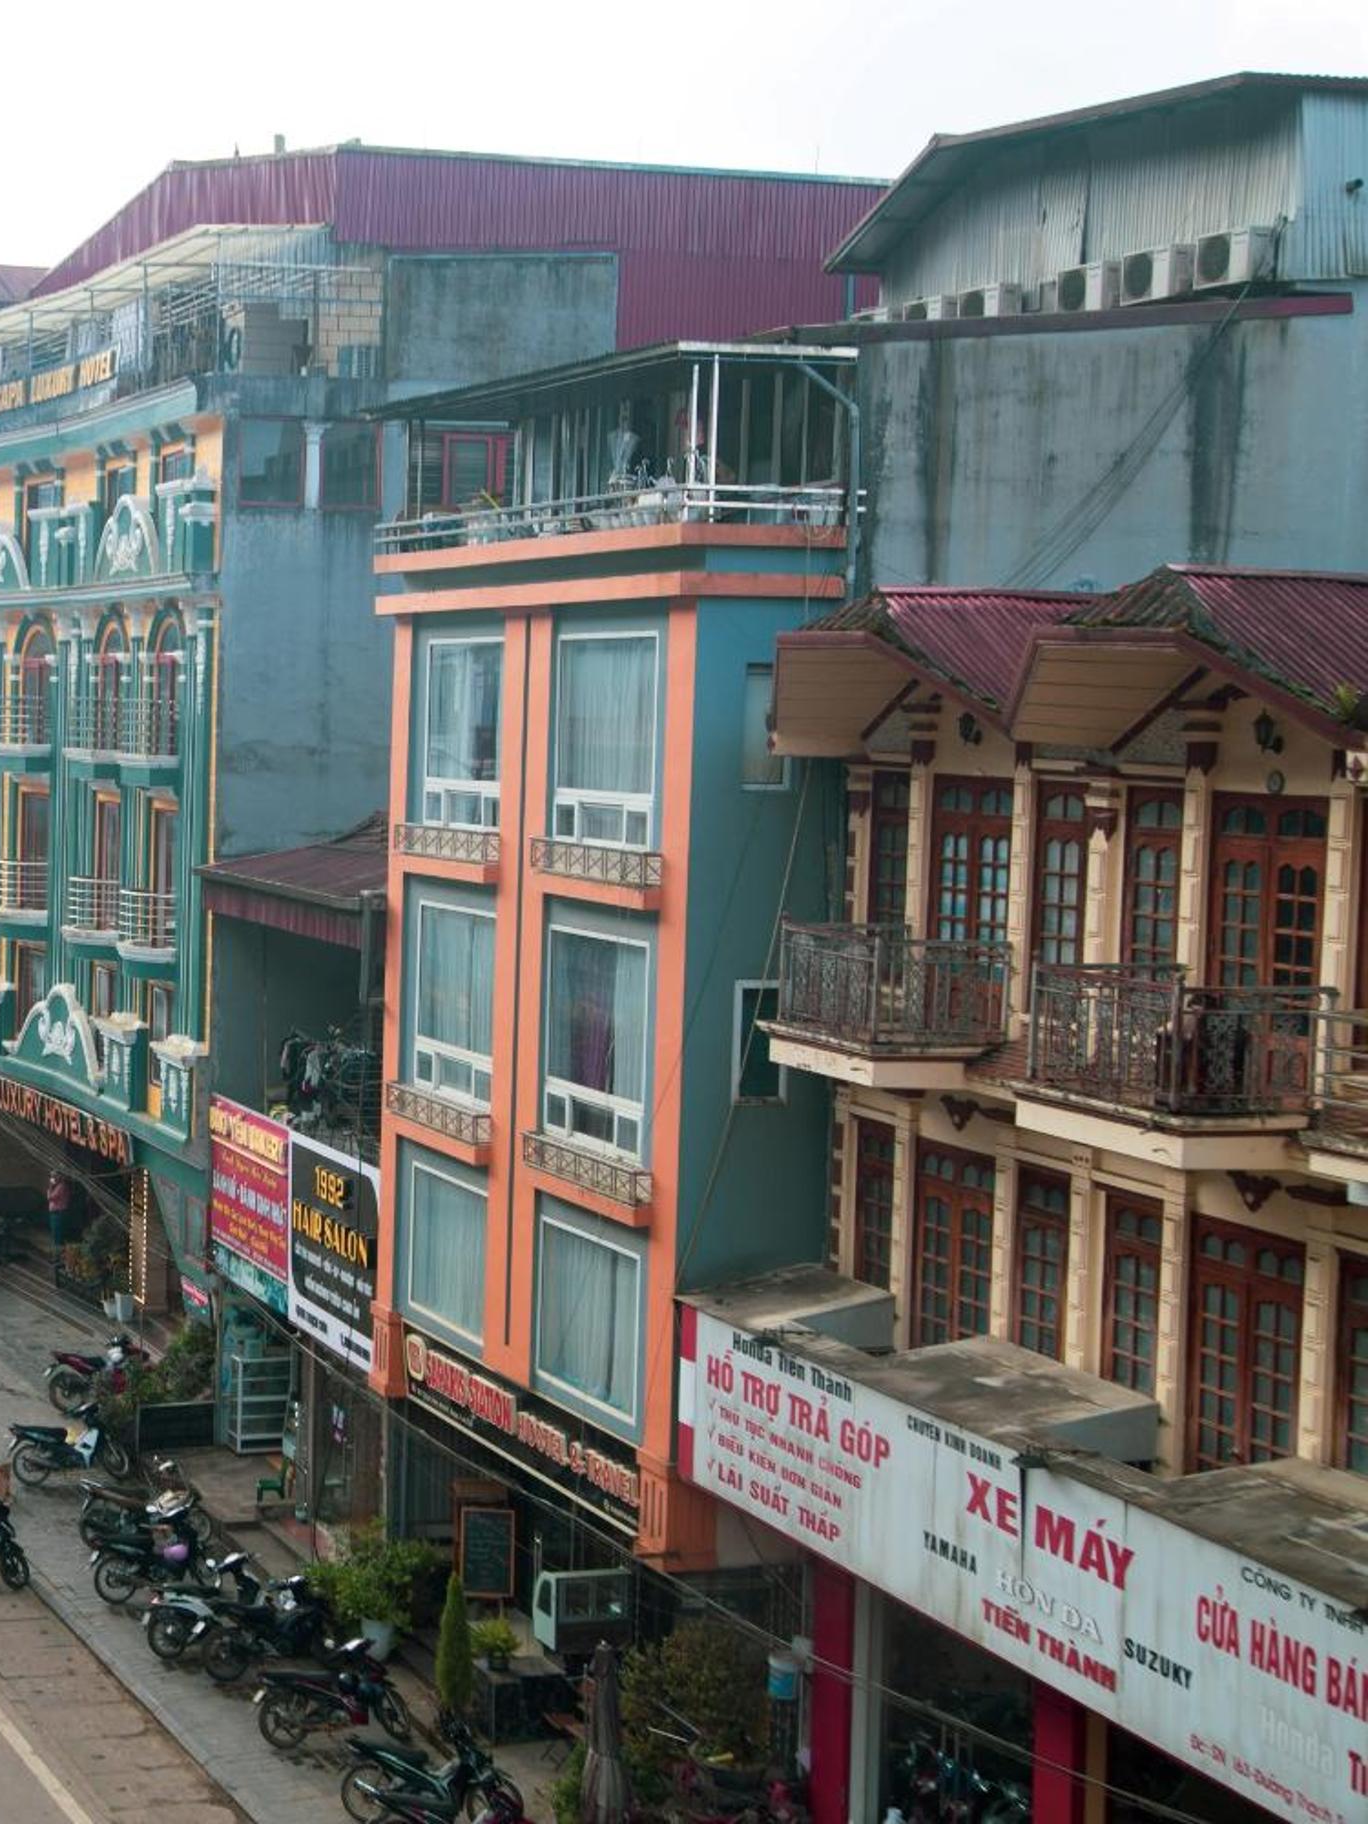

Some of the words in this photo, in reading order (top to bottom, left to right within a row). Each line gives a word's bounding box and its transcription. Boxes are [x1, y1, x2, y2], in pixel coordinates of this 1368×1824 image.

[43, 1097, 86, 1147] HOTEL
[87, 1117, 97, 1150] &
[99, 1124, 128, 1166] SPA
[315, 1166, 344, 1209] 1992
[293, 1199, 322, 1244] HAIR
[324, 1217, 367, 1268] SALON
[468, 1373, 515, 1435] STATION
[706, 1350, 734, 1395] HỖ
[740, 1371, 781, 1422] TRỢ
[789, 1393, 831, 1443] TRẢ
[839, 1419, 891, 1469] GÓP
[584, 1449, 639, 1507] TRAVEL
[969, 1441, 1002, 1471] DOANH
[749, 1481, 790, 1516] SUẤT
[796, 1504, 841, 1542] THẤP
[965, 1470, 1018, 1537] XE
[1035, 1504, 1135, 1591] MÁY
[923, 1529, 978, 1575] YAMAHA
[1241, 1565, 1292, 1600] CÔNG
[1299, 1591, 1316, 1611] TY
[1036, 1628, 1116, 1693] THÀNH
[1123, 1637, 1192, 1689] SUZUKY
[1196, 1583, 1239, 1658] CỬA
[1250, 1616, 1316, 1697] HÀNG
[1259, 1700, 1334, 1776] Honda
